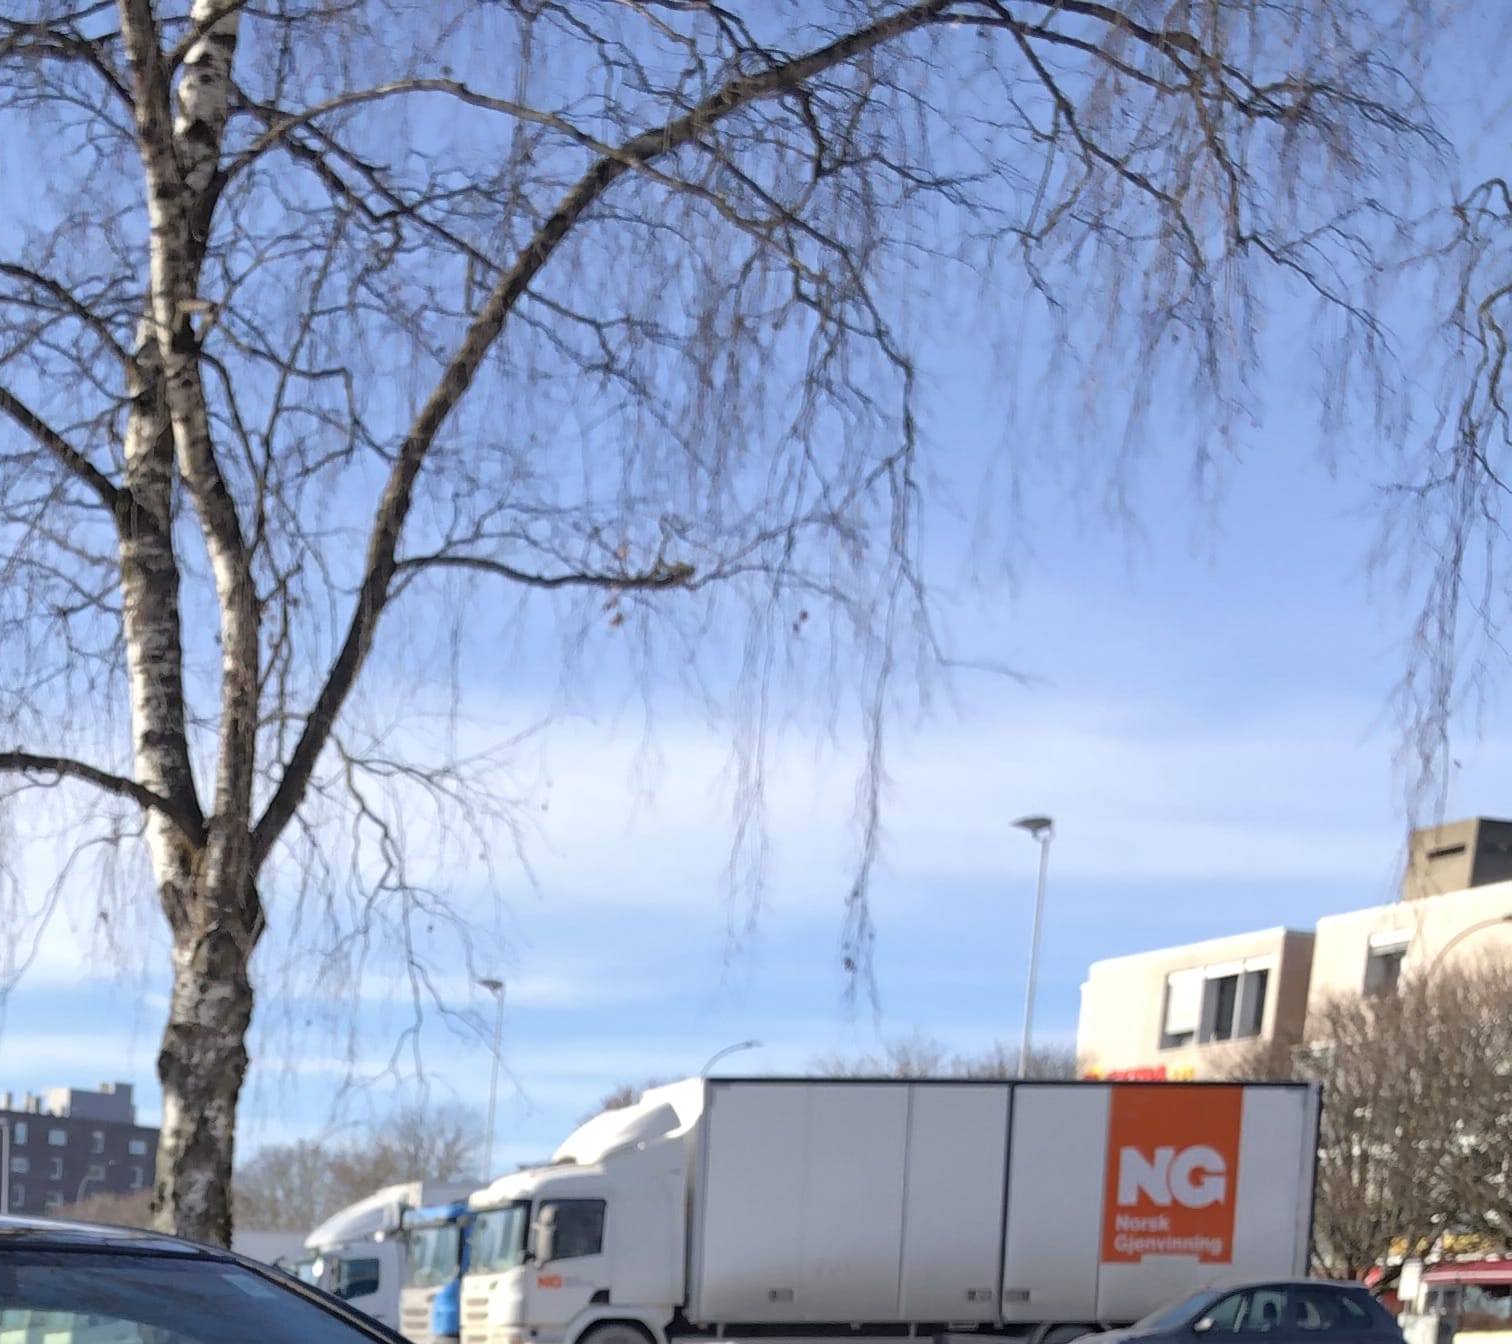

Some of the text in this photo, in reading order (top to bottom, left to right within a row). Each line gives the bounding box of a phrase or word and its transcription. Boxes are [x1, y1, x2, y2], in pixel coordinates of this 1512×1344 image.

[1117, 1145, 1227, 1208] NG
[1115, 1214, 1170, 1231] Norsk
[1114, 1235, 1222, 1256] Gjenvinning
